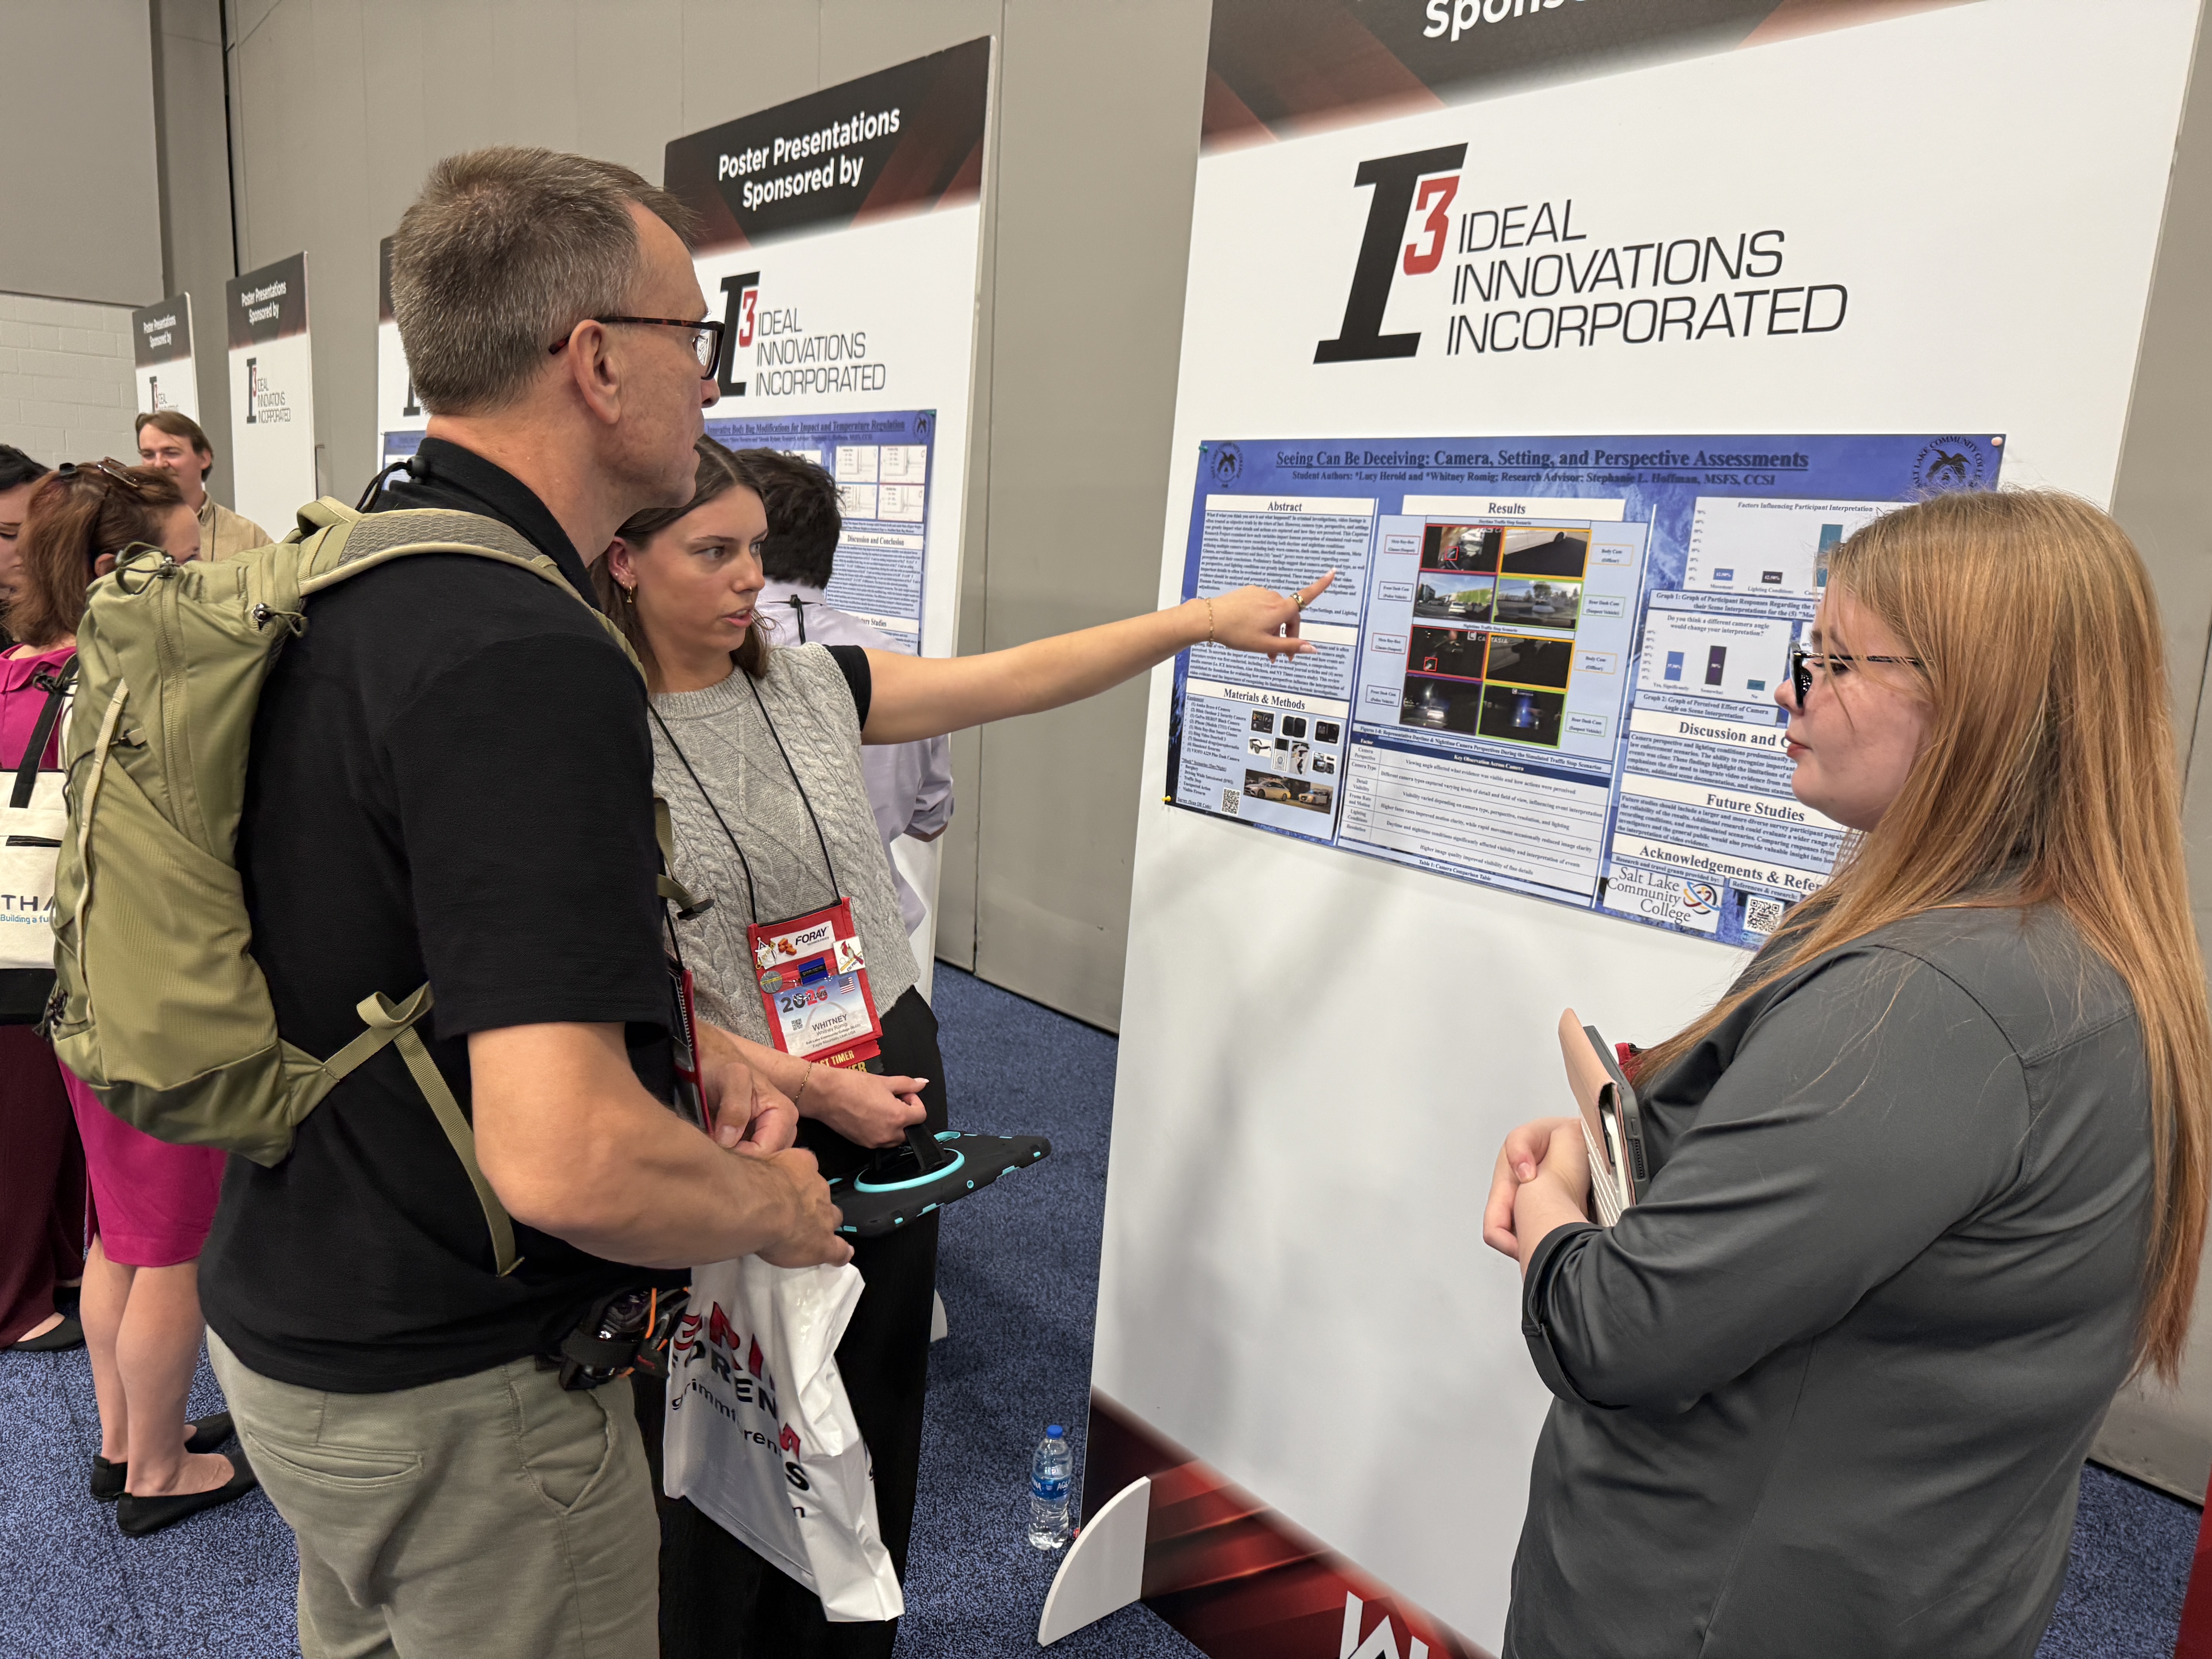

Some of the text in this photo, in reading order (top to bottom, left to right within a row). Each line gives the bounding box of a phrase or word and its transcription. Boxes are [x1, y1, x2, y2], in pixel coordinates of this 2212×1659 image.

[719, 107, 900, 181] Poster Presentations
[743, 154, 864, 211] Sponsored by
[1457, 199, 1587, 254] IDEAL
[1451, 230, 1785, 306] INNOVATIONS
[242, 280, 287, 307] Poster Presentations
[249, 301, 279, 326] Sponsored by
[758, 308, 802, 337] IDEAL
[1446, 283, 1848, 356] INCORPORATED
[757, 332, 866, 367] INNOVATIONS
[756, 364, 886, 397] INCORPORATED
[756, 423, 790, 433] Modifications
[800, 422, 819, 433] Impact
[820, 422, 832, 431] and
[833, 421, 870, 432] Temperature
[871, 420, 905, 432] Regulation
[1930, 436, 1977, 452] COMMUNITY
[1276, 450, 1810, 470] Seeing Can Be Deceiving: Camera, Setting, and Perspective Assessments
[1292, 471, 1319, 479] Student
[1321, 471, 1353, 480] Authors:
[1380, 472, 1406, 481] Herold
[1408, 472, 1423, 481] and
[1501, 472, 1542, 482] Research
[1543, 472, 1584, 483] Advisor:
[1585, 473, 1636, 485] Stephanie
[1637, 473, 1649, 484] L.
[1743, 474, 1776, 486] CCSI
[1267, 501, 1302, 512] Abstract
[1488, 502, 1526, 514] Results
[848, 535, 869, 544] Discussion
[880, 538, 904, 546] Conclusion
[1707, 596, 1738, 605] Participant
[1739, 599, 1768, 607] Responses
[1769, 601, 1800, 610] Regarding
[1724, 606, 1767, 615] Interpretations
[1721, 627, 1764, 637] interpretation?
[1224, 689, 1305, 710] Materials & Methods
[1643, 694, 1661, 702] Graph
[1668, 697, 1686, 705] Graph
[1693, 700, 1720, 709] Perceived
[1745, 707, 1769, 715] Camera
[1663, 704, 1680, 712] Angle
[1704, 709, 1743, 721] Interpretation
[1679, 721, 1747, 742] Discussion
[1750, 732, 1776, 747] and
[1653, 737, 1682, 747] perspective
[1694, 744, 1716, 752] lighting
[1717, 747, 1745, 756] conditions
[1706, 793, 1805, 822] Future Studies
[1436, 864, 1452, 872] Camera
[1453, 868, 1479, 879] Comparison
[1616, 856, 1639, 865] Research
[1667, 867, 1684, 876] grants
[1685, 871, 1709, 882] provided
[1619, 866, 1680, 892] Salt Lake
[1639, 845, 1822, 893] Acknowledgements & Refer
[1607, 876, 1682, 907] Community
[1732, 881, 1763, 892] References
[1770, 889, 1797, 900] research:
[0, 914, 30, 924] Building
[1640, 898, 1691, 924] College
[796, 927, 827, 945] FORAY
[781, 986, 828, 1013] 2026
[814, 990, 828, 999] LOUIS
[812, 1014, 847, 1031] WHITNEY
[831, 1050, 854, 1065] TIMER
